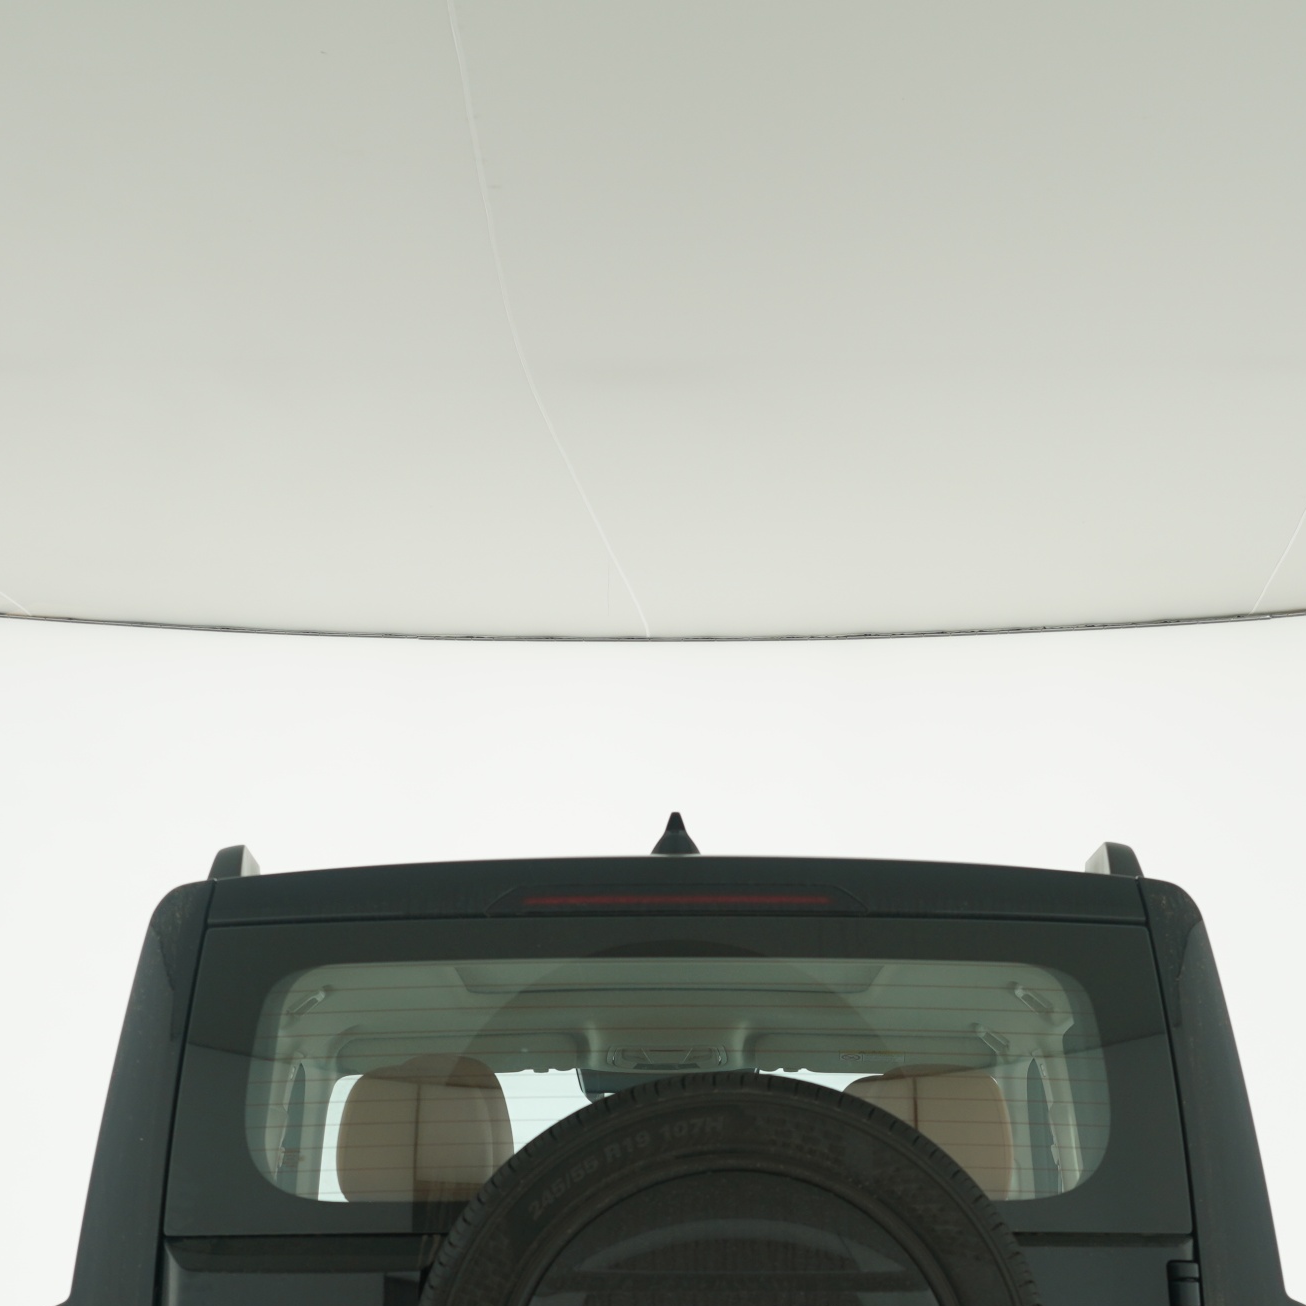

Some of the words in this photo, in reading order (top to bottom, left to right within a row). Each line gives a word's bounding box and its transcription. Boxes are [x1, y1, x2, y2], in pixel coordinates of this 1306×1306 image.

[527, 1152, 600, 1222] 245/55
[602, 1129, 651, 1165] R19
[657, 1115, 726, 1144] 107H
